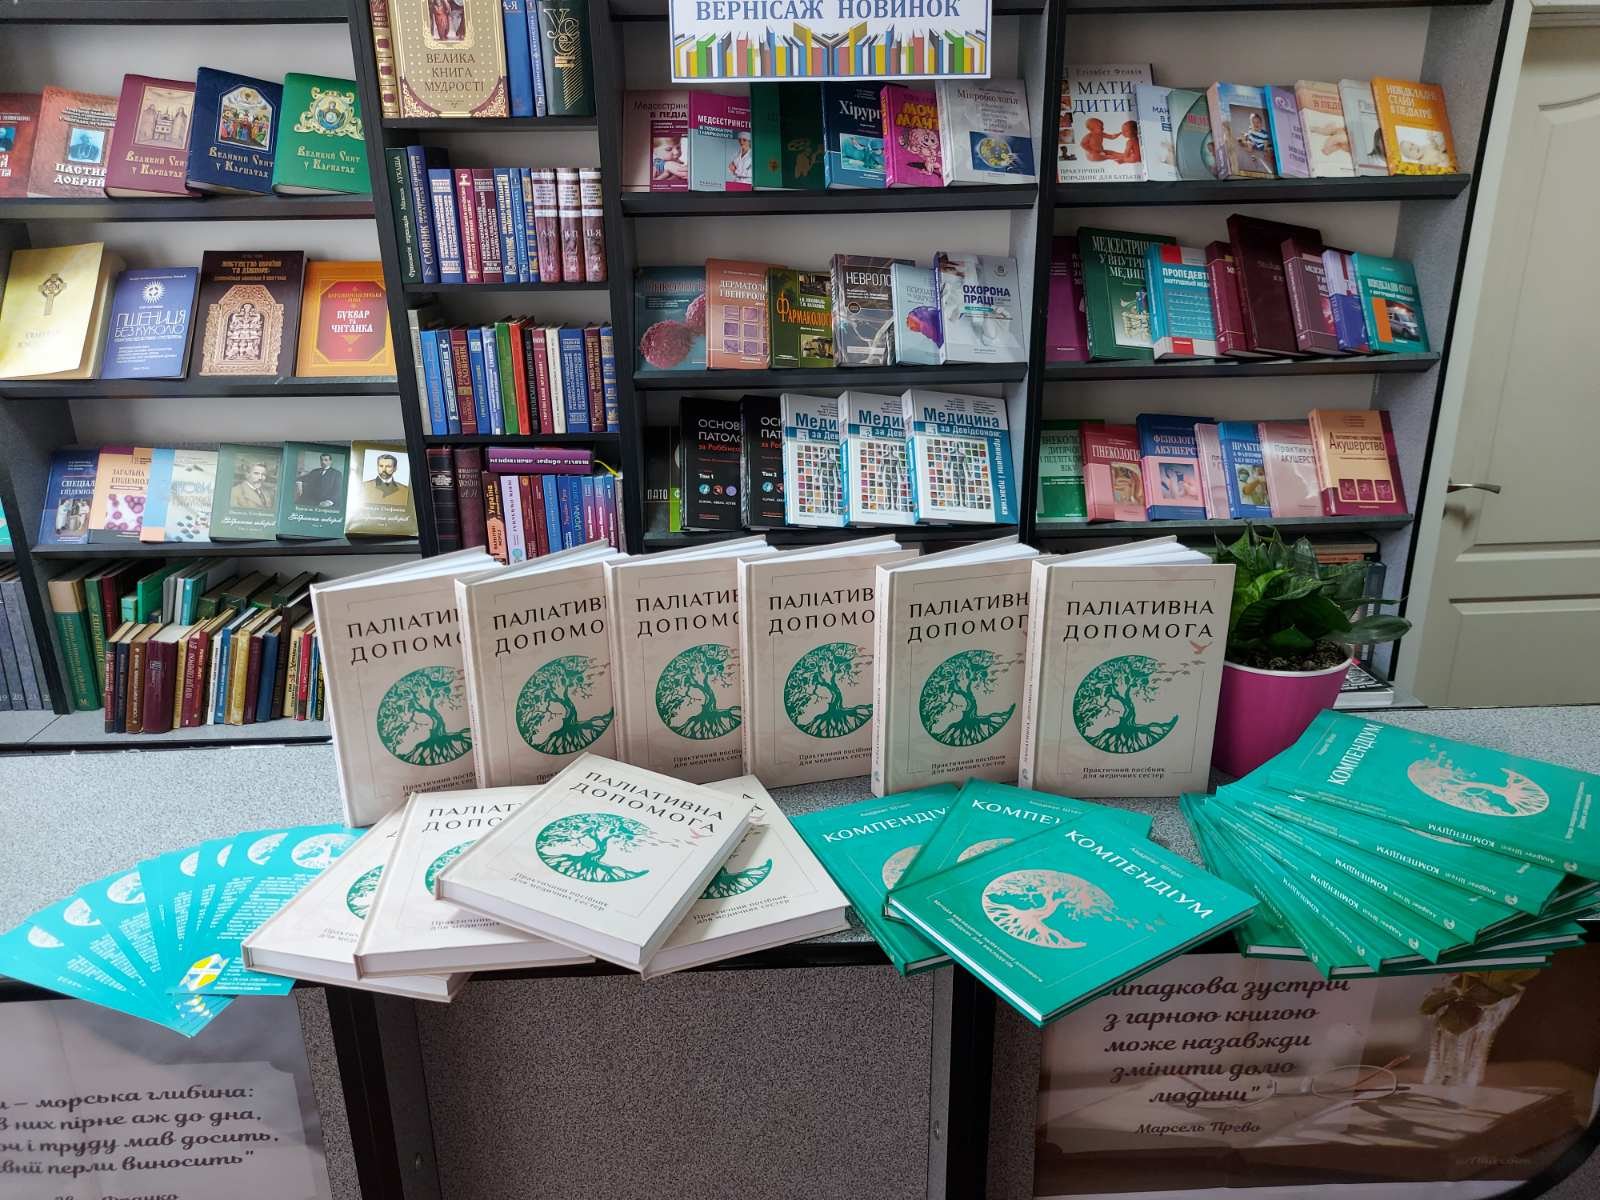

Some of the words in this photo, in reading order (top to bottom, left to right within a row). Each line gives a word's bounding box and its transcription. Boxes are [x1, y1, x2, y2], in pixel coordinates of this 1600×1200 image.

[696, 0, 824, 20] ВЕРНІСАЖ
[838, 0, 961, 19] НОВИНОК
[426, 53, 476, 64] ВЕЛИКА
[432, 67, 473, 78] КНИГА
[424, 81, 484, 94] МУДРОСТІ
[1078, 81, 1132, 95] МАТИ
[169, 153, 186, 167] Ски
[420, 225, 434, 265] СЛОВНИК
[963, 284, 1011, 297] ОХОРОНА
[963, 295, 994, 306] ПРАЦІ
[116, 310, 187, 327] ПШЕНИЦЯ
[336, 310, 370, 319] БУКВАР
[114, 325, 135, 338] БЕЗ
[134, 323, 185, 337] КУКОЛЮ
[331, 323, 373, 333] ЧИТАНКА
[698, 418, 740, 430] ОСНОВ
[795, 412, 837, 431] Меди
[859, 409, 905, 428] Меди
[924, 407, 1000, 429] Медицина
[1329, 432, 1385, 453] Акушерство
[768, 587, 874, 611] ПАЛІАТИВ
[909, 592, 1029, 618] ПАЛІАТИВН
[1066, 600, 1215, 616] ПАЛІАТИВНА
[347, 608, 458, 639] ПАЛІАТИ
[492, 595, 606, 631] ПАЛІАТИВ
[769, 609, 875, 636] ДОПОМО
[494, 620, 604, 657] ДОПОМО
[907, 614, 1029, 644] ДОПОМОГ
[1063, 622, 1214, 642] ДОПОМОГА
[673, 752, 717, 762] Практичний
[799, 750, 841, 760] Практичний
[932, 758, 974, 769] Практичний
[976, 755, 1006, 763] посібник
[1326, 722, 1386, 787] КОМПЕНДІУМ
[946, 764, 981, 773] медичних
[982, 760, 1006, 768] сестер
[585, 771, 723, 821] ПАЛІАТИВНА
[429, 803, 517, 817] ПАЛІАТ
[569, 782, 715, 833] ДОПОМОГА
[1427, 822, 1496, 849] КОМПЕНДІУМ
[1375, 845, 1441, 876] КОМПЕНДІУМ
[514, 872, 568, 895] Практичний
[1064, 828, 1216, 920] КОМПЕНДІУМ
[1334, 857, 1390, 893] КОМПЕНДІУМ
[1309, 872, 1360, 910] КОМПЕНДІУМ
[693, 902, 746, 920] Практичний
[747, 895, 788, 907] посібник
[696, 916, 713, 925] для
[714, 906, 759, 921] медичних
[1105, 976, 1239, 1002] ипадкова
[1102, 1012, 1119, 1032] з
[1125, 1008, 1221, 1033] гарною
[1224, 1004, 1318, 1029] книгою
[1103, 1035, 1178, 1053] може
[1181, 1031, 1311, 1053] назавжди
[1110, 1061, 1227, 1084] змінити
[1229, 1062, 1296, 1082] долю
[35, 1089, 140, 1112] морська
[148, 1084, 254, 1100] глибина:
[1148, 1083, 1260, 1107] людини"
[15, 1119, 57, 1131] них
[60, 1114, 125, 1133] пірне
[131, 1112, 170, 1124] аж
[174, 1111, 205, 1127] до
[209, 1108, 261, 1126] дна.
[1134, 1120, 1206, 1136] Марсель
[1209, 1120, 1261, 1136] Прево
[27, 1139, 36, 1152] і
[39, 1137, 118, 1157] труду
[124, 1131, 177, 1148] мав
[181, 1129, 279, 1150] досить.
[48, 1157, 117, 1178] перли
[121, 1150, 254, 1171] виносить"
